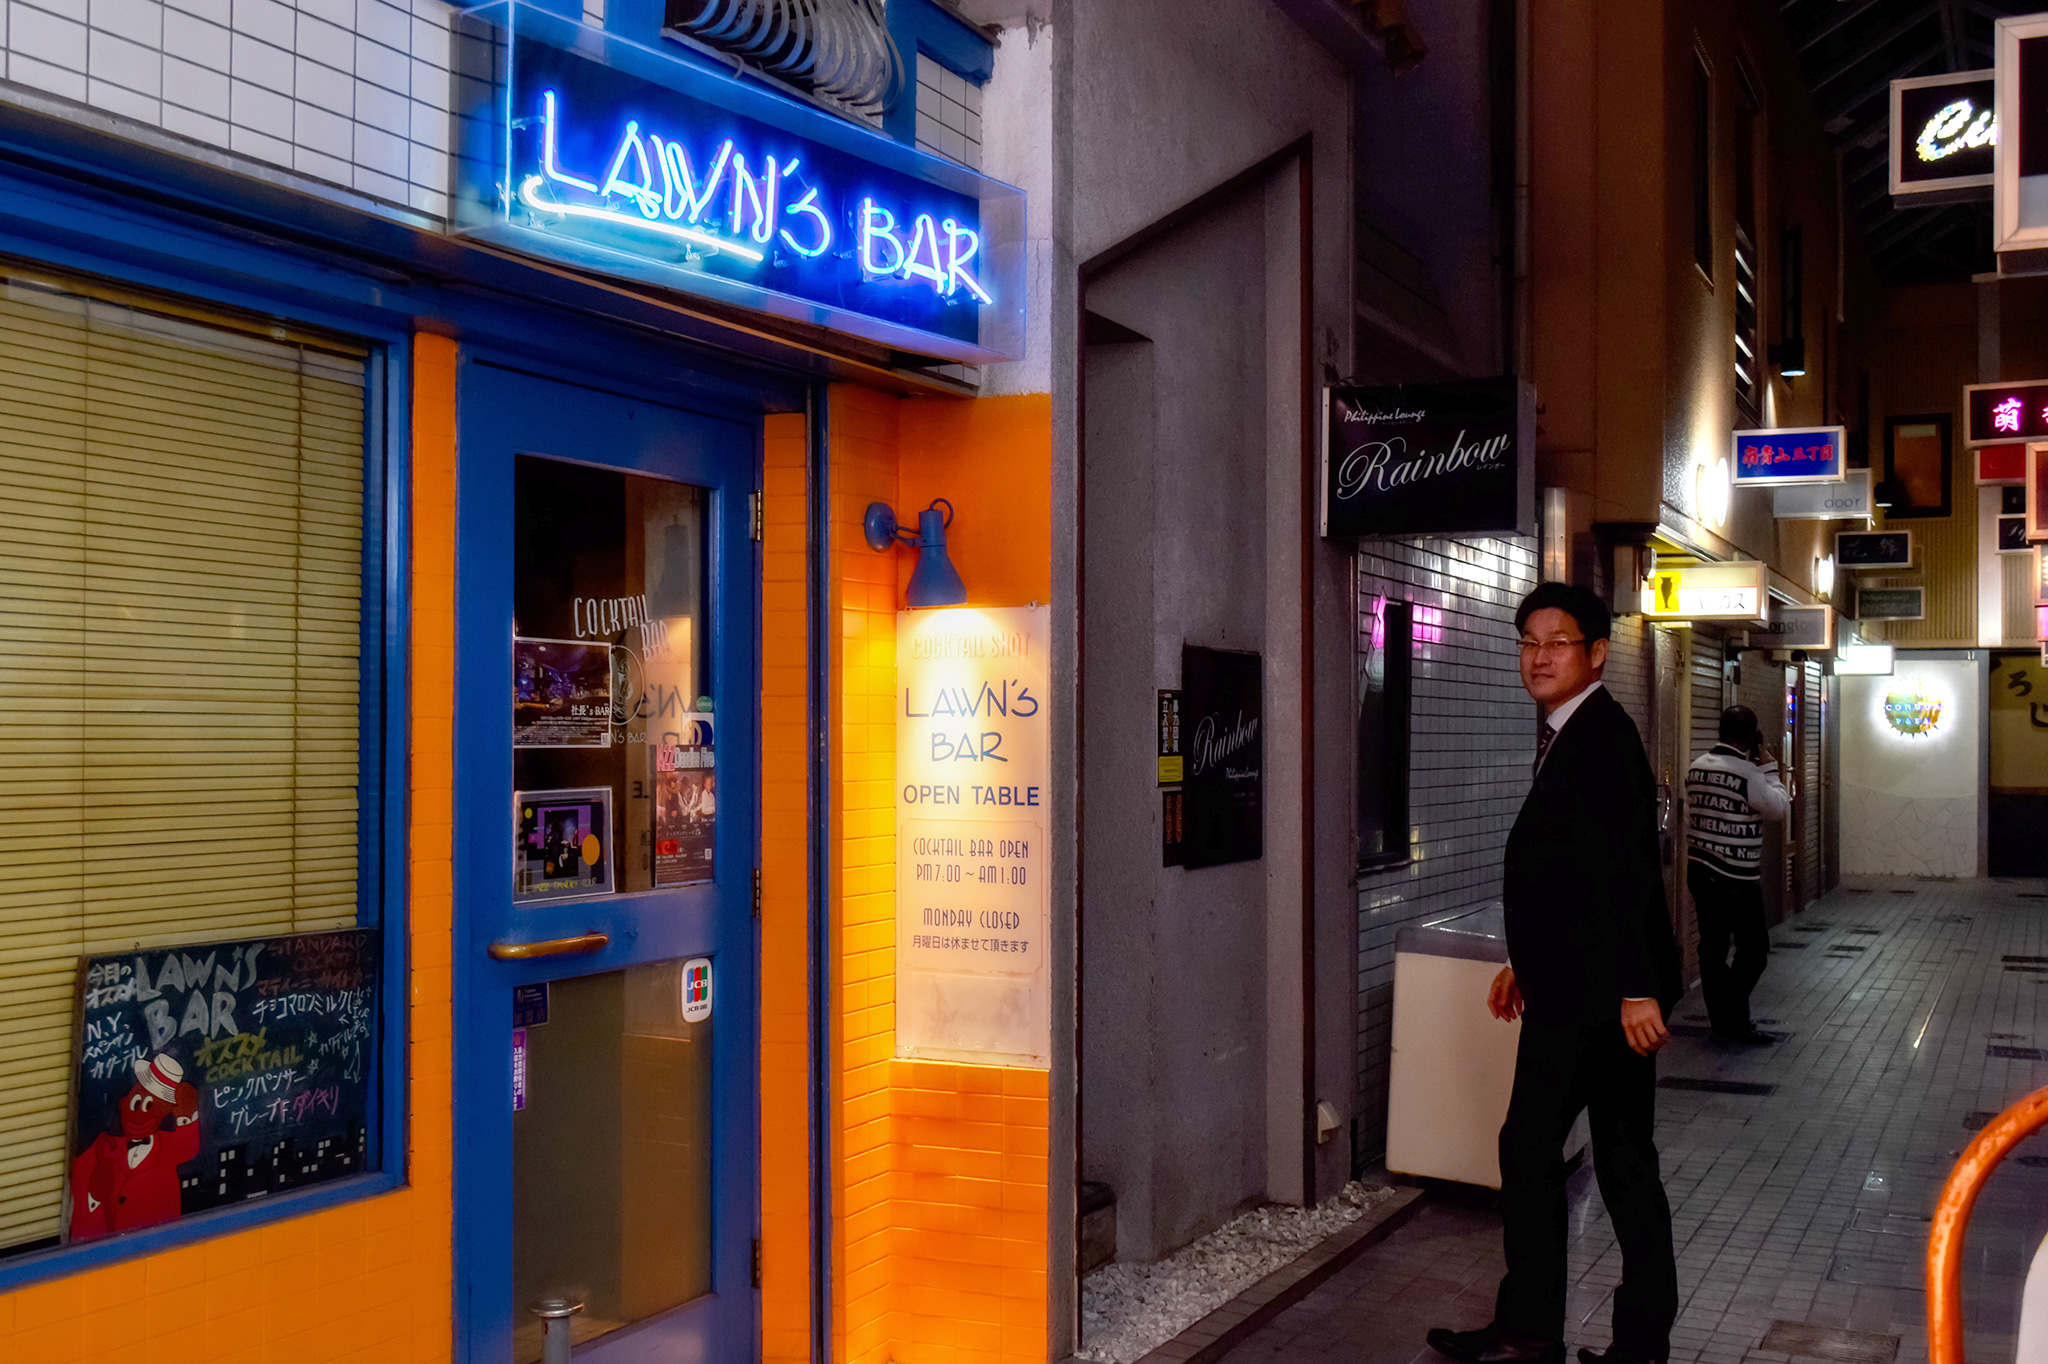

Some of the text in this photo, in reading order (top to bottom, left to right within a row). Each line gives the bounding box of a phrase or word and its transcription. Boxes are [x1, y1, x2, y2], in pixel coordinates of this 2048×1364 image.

[544, 89, 993, 304] LAWN'S BAR
[1394, 408, 1426, 422] Lounge
[1336, 429, 1511, 500] Rainbow
[1824, 484, 1861, 509] door
[573, 594, 671, 662] COCKTAIL BAR
[911, 632, 1030, 660] COCKTAIL SHOT
[905, 679, 1039, 718] LAWN'S
[931, 731, 1008, 763] BAR
[1193, 709, 1258, 776] Rainbow
[903, 784, 1040, 806] OPEN TABLE
[912, 837, 1029, 859] COCKTAIL BAR OPEN
[923, 908, 1020, 930] MONDAY CLOSED
[912, 934, 1030, 953] 月曜日は休ませて頂きます
[87, 964, 132, 986] 今月の
[687, 979, 708, 991] JCB
[145, 989, 239, 1050] BAR
[193, 1027, 268, 1068] オススメ
[206, 1045, 304, 1083] COCKTAIL
